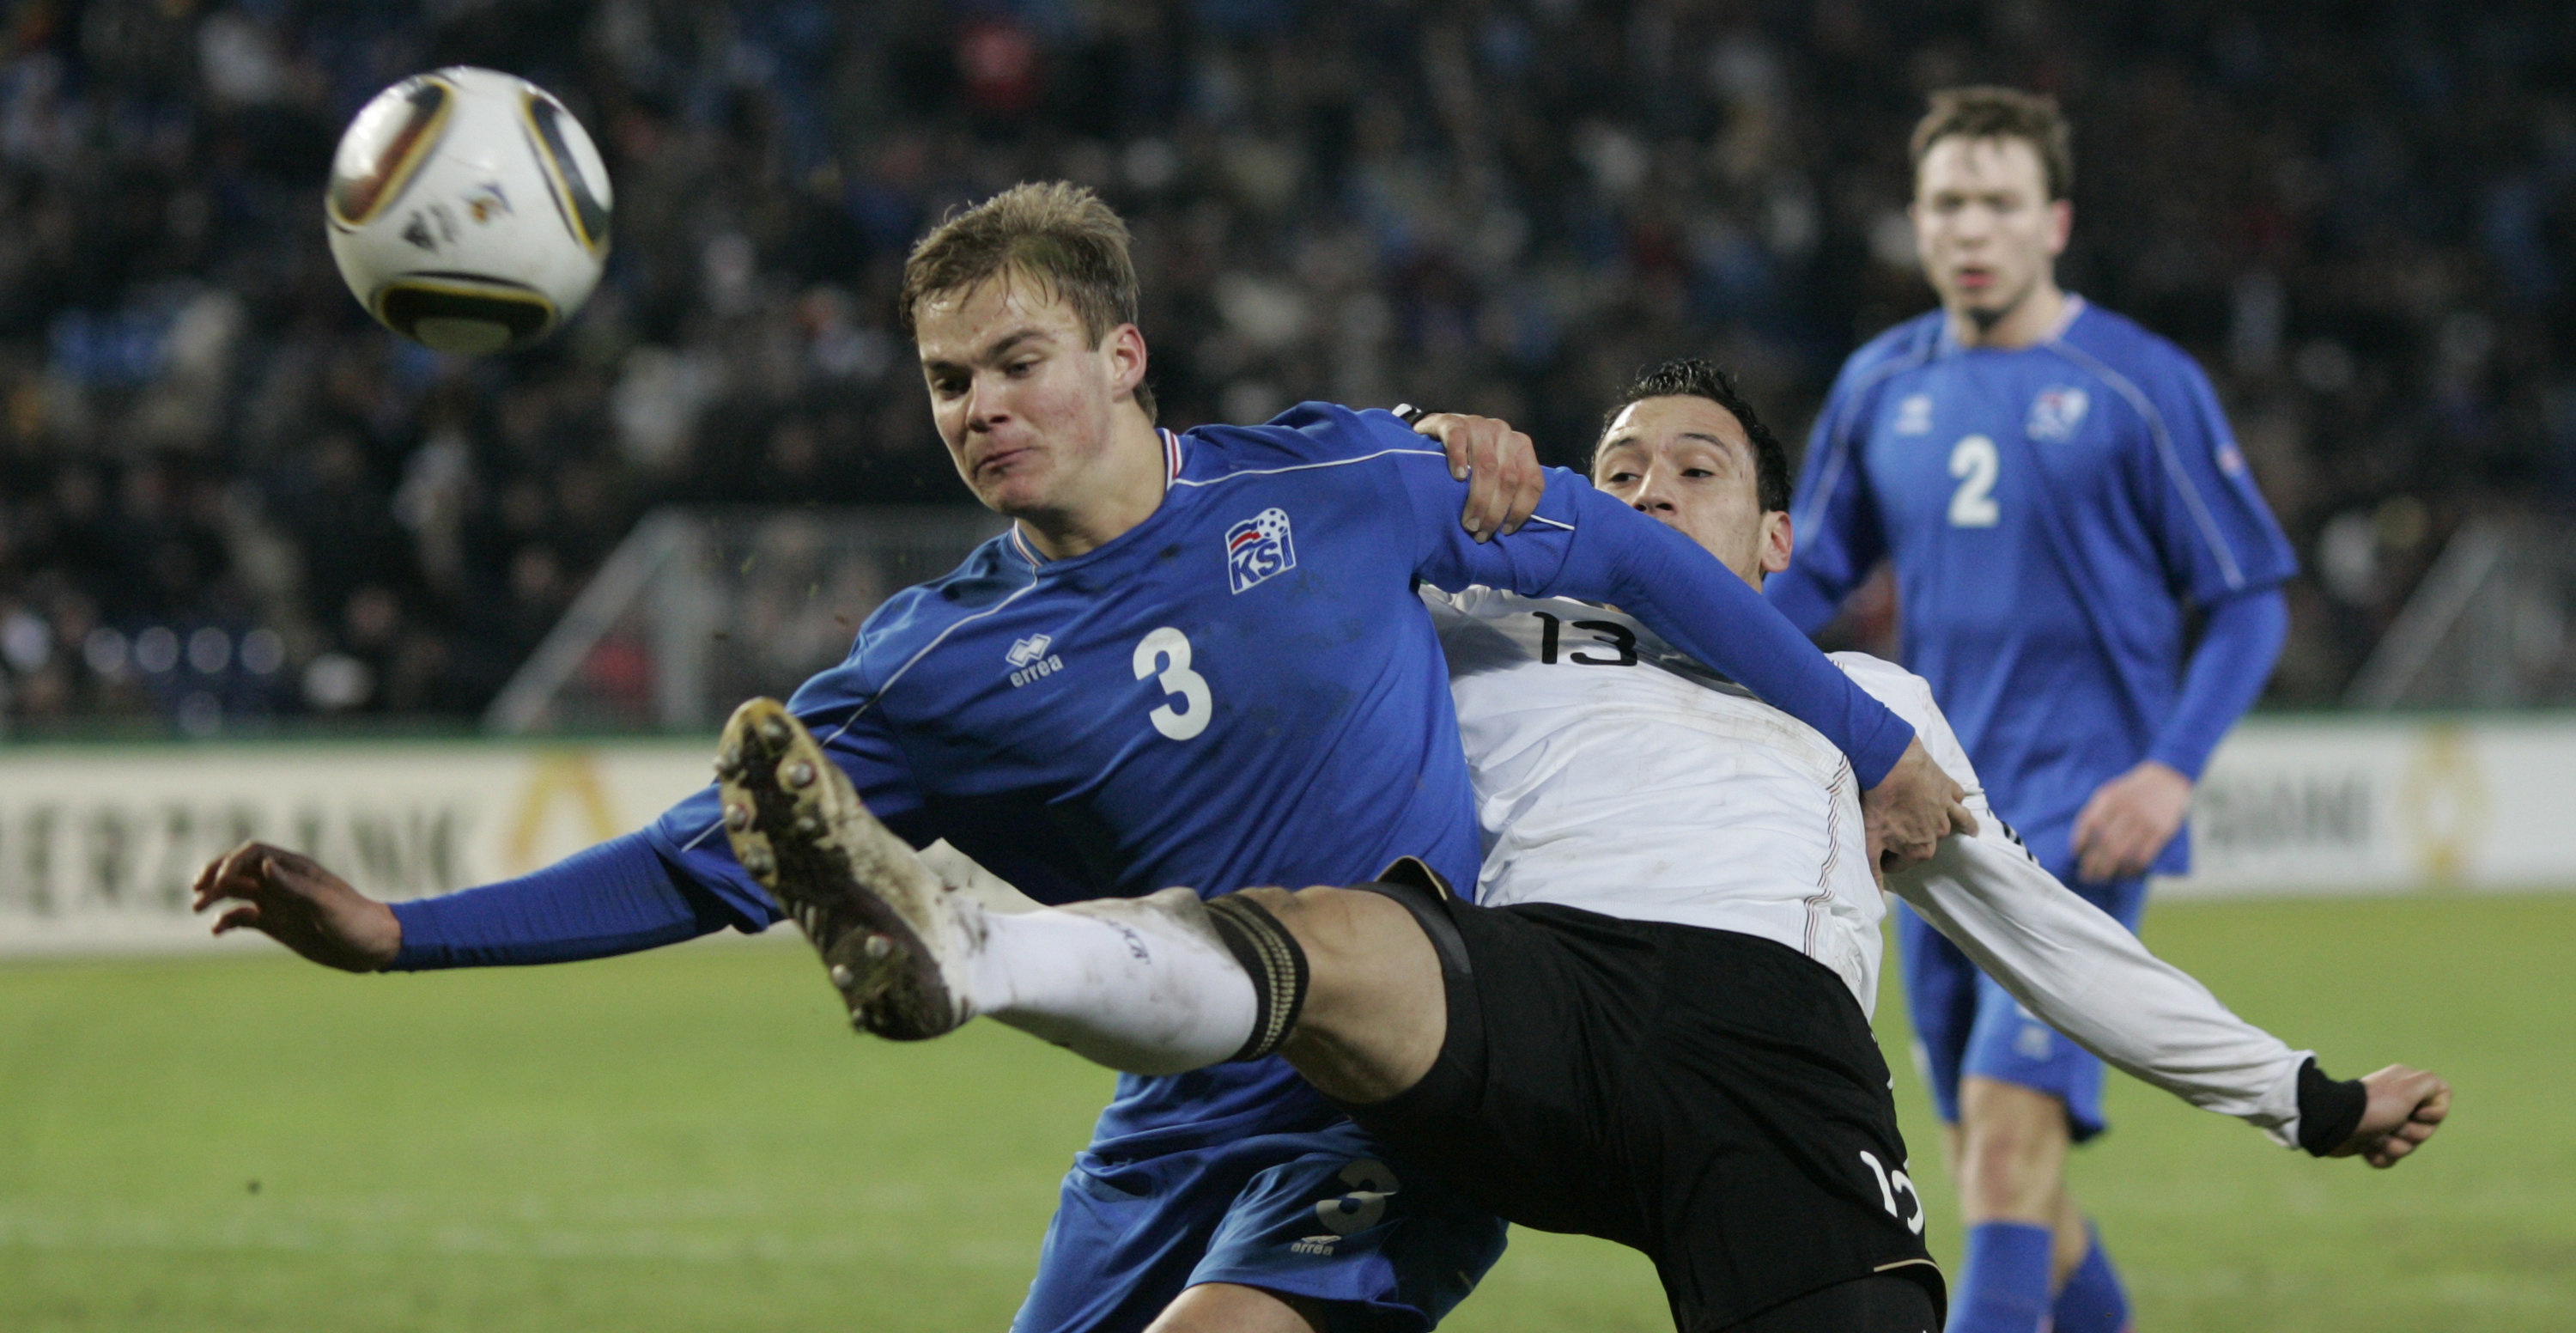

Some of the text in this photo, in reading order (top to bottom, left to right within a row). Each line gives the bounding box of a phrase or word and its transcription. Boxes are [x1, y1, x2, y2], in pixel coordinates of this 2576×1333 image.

[1947, 431, 2002, 530] 2
[1010, 654, 1064, 688] errea
[1532, 611, 1637, 666] 13
[1133, 626, 1213, 741] 3
